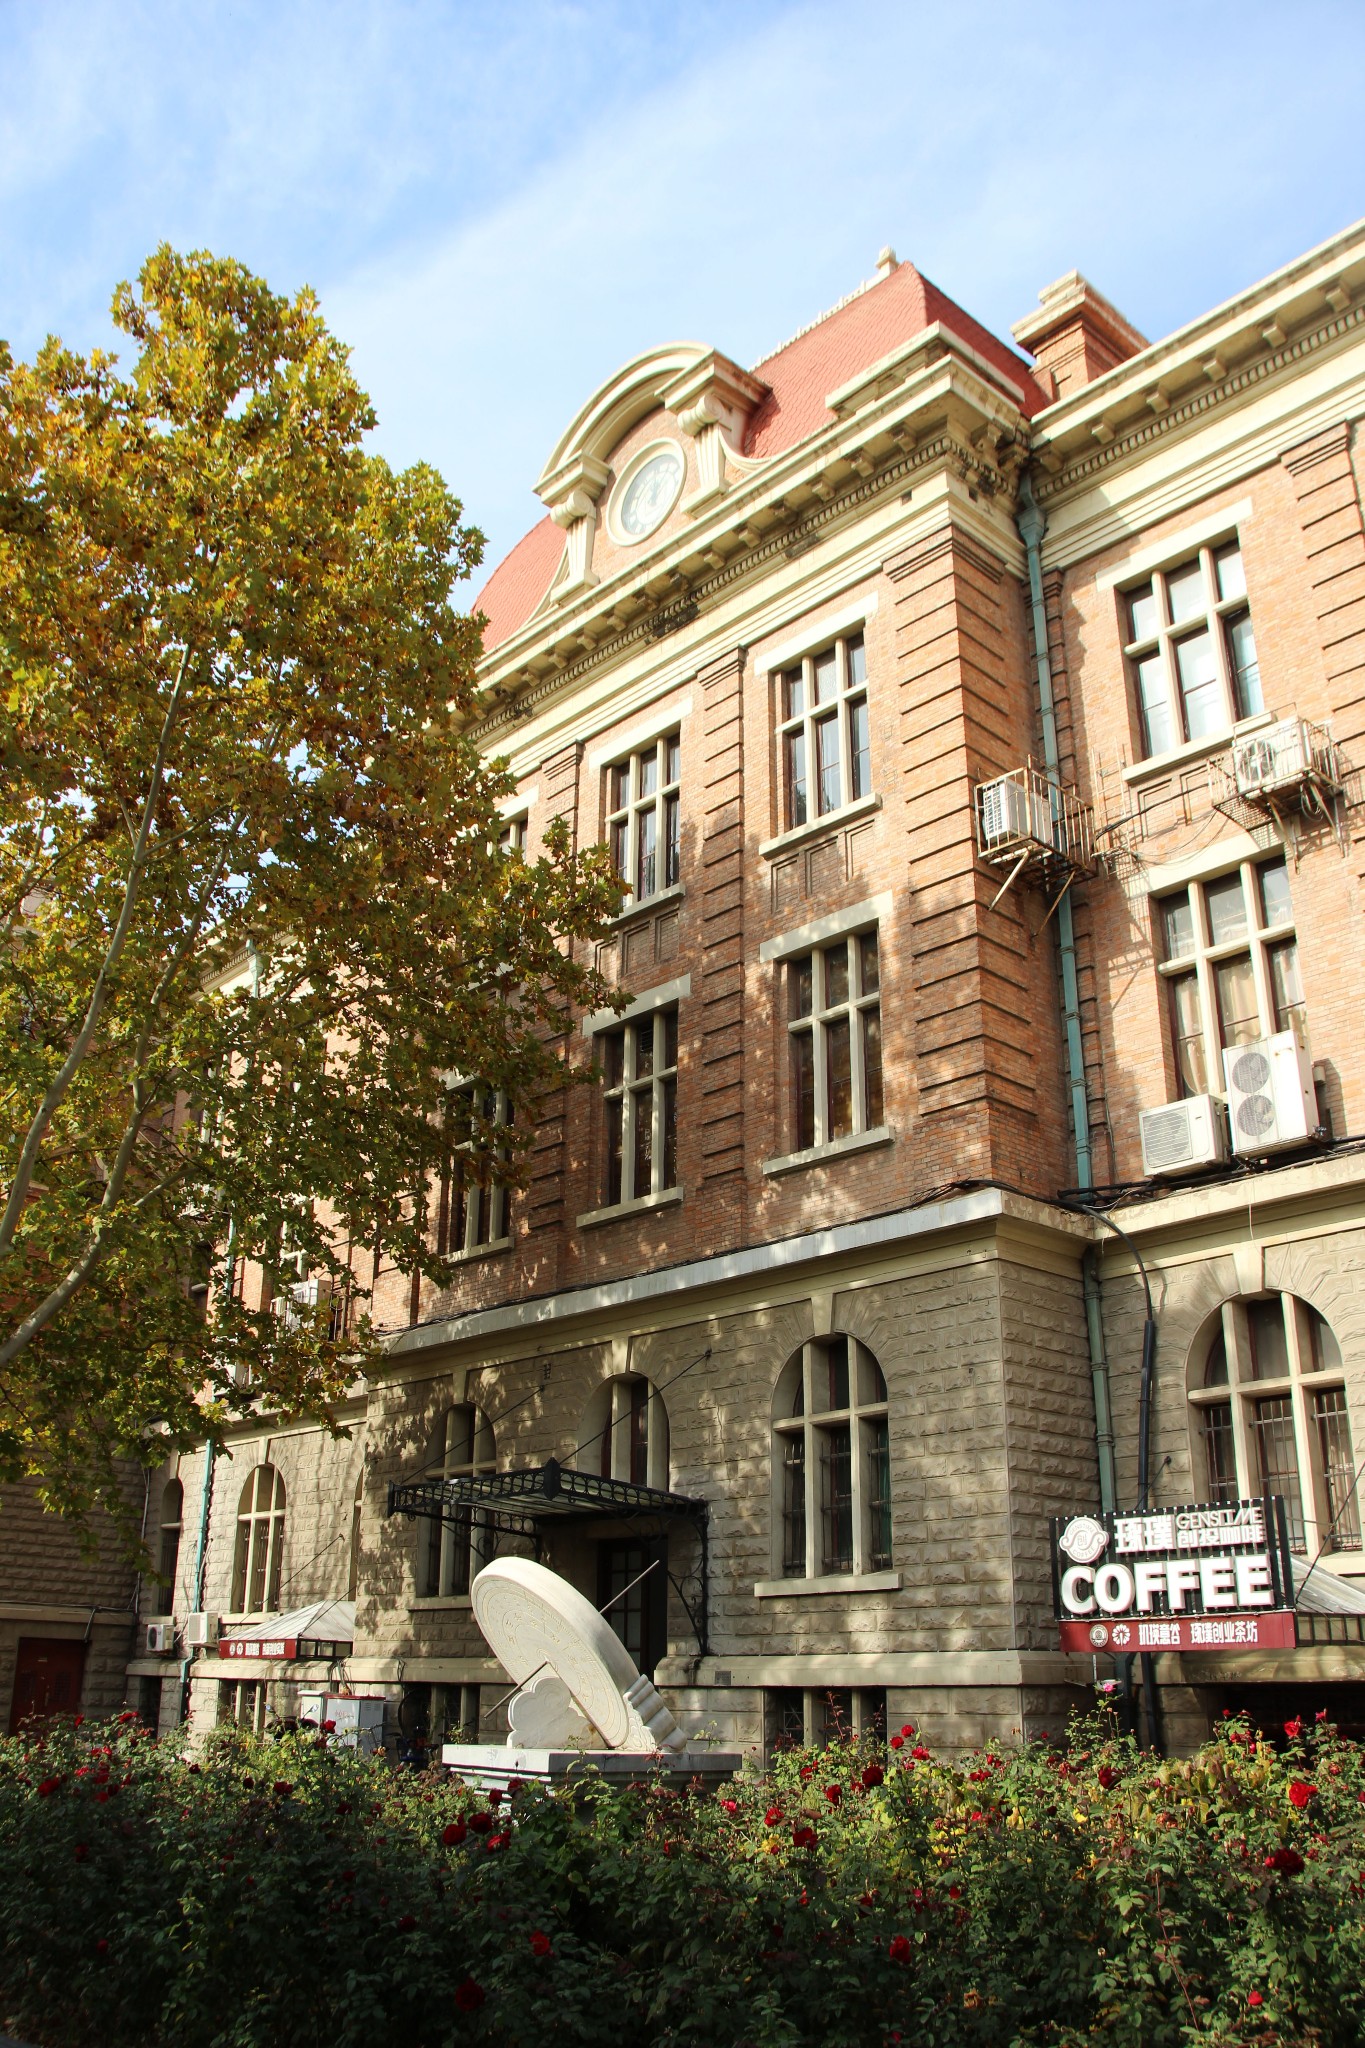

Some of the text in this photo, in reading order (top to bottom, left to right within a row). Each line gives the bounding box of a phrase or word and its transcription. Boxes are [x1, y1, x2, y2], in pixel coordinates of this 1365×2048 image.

[1177, 1525, 1264, 1548] 创投咖啡
[1072, 1545, 1095, 1558] COFFEE
[1061, 1554, 1275, 1614] COFFEE
